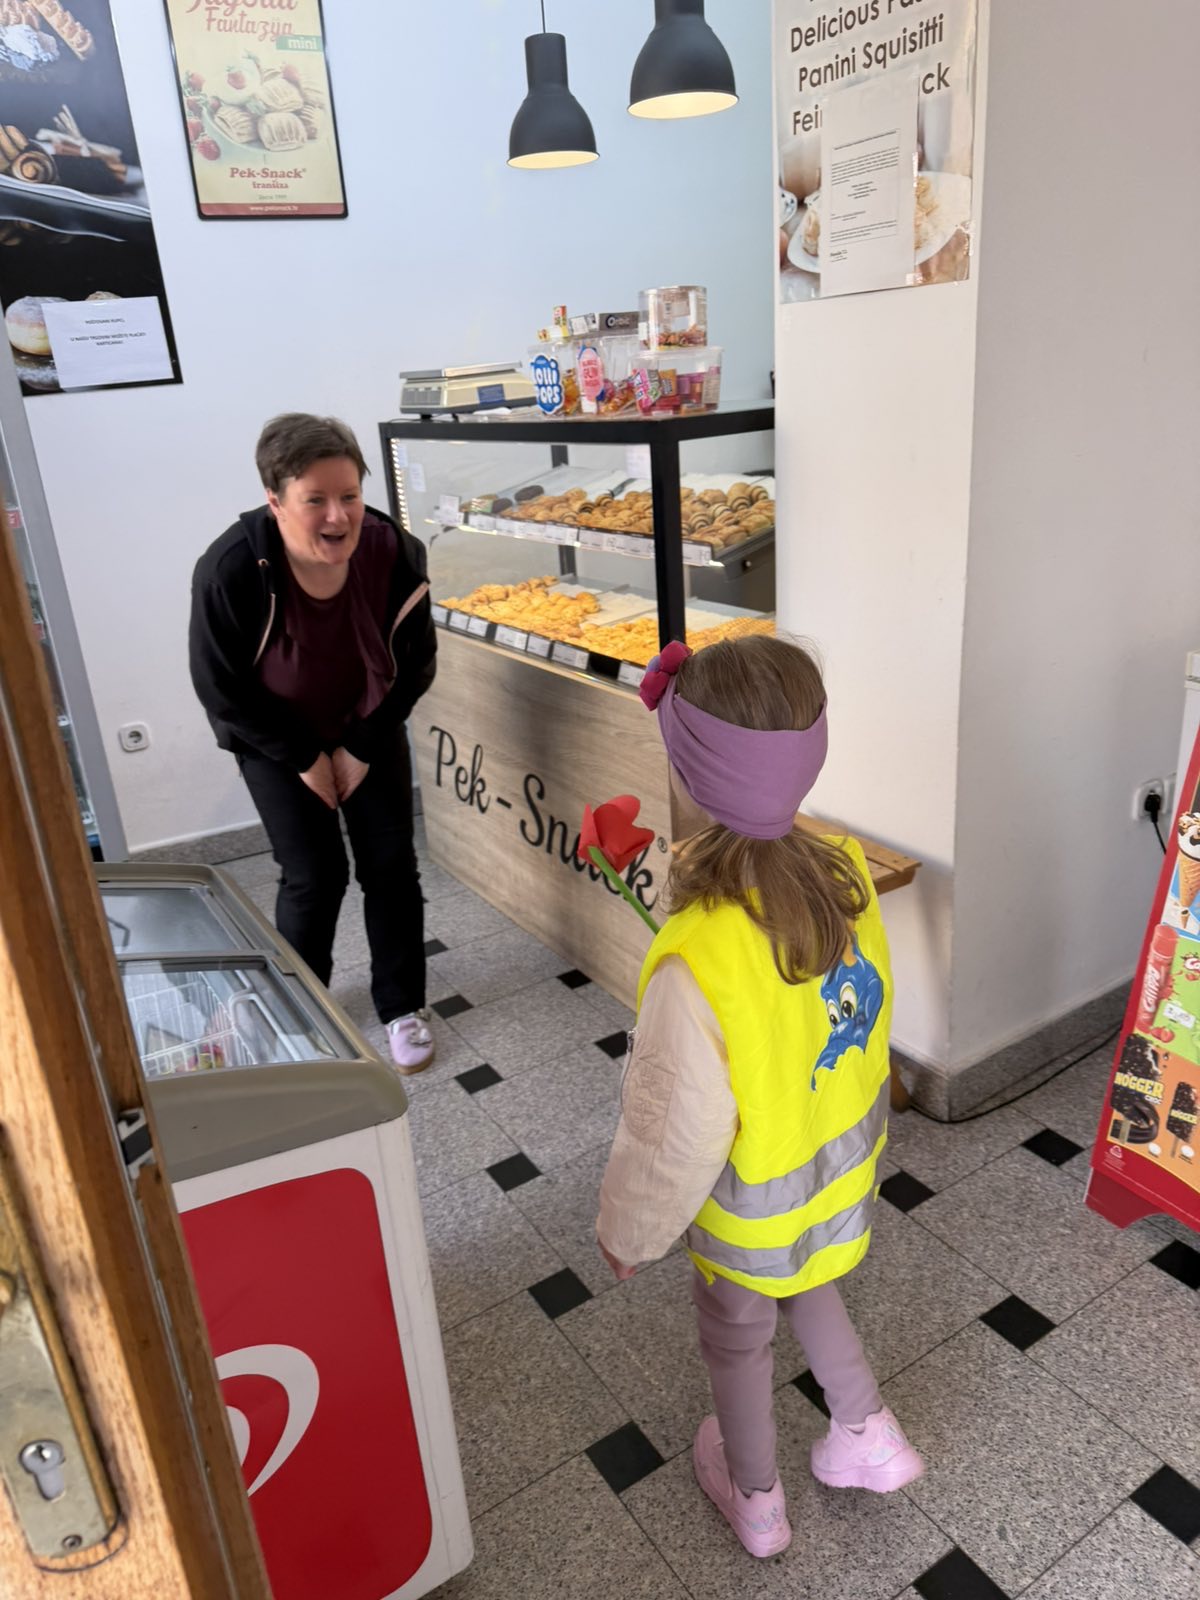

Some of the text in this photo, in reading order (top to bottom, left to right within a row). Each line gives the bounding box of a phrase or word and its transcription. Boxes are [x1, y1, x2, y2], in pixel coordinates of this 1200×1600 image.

[790, 0, 880, 53] Delicious
[287, 36, 318, 50] mini
[798, 13, 945, 92] Panini Squisitti
[792, 104, 823, 136] Fei
[1114, 1072, 1165, 1098] NOGGER
